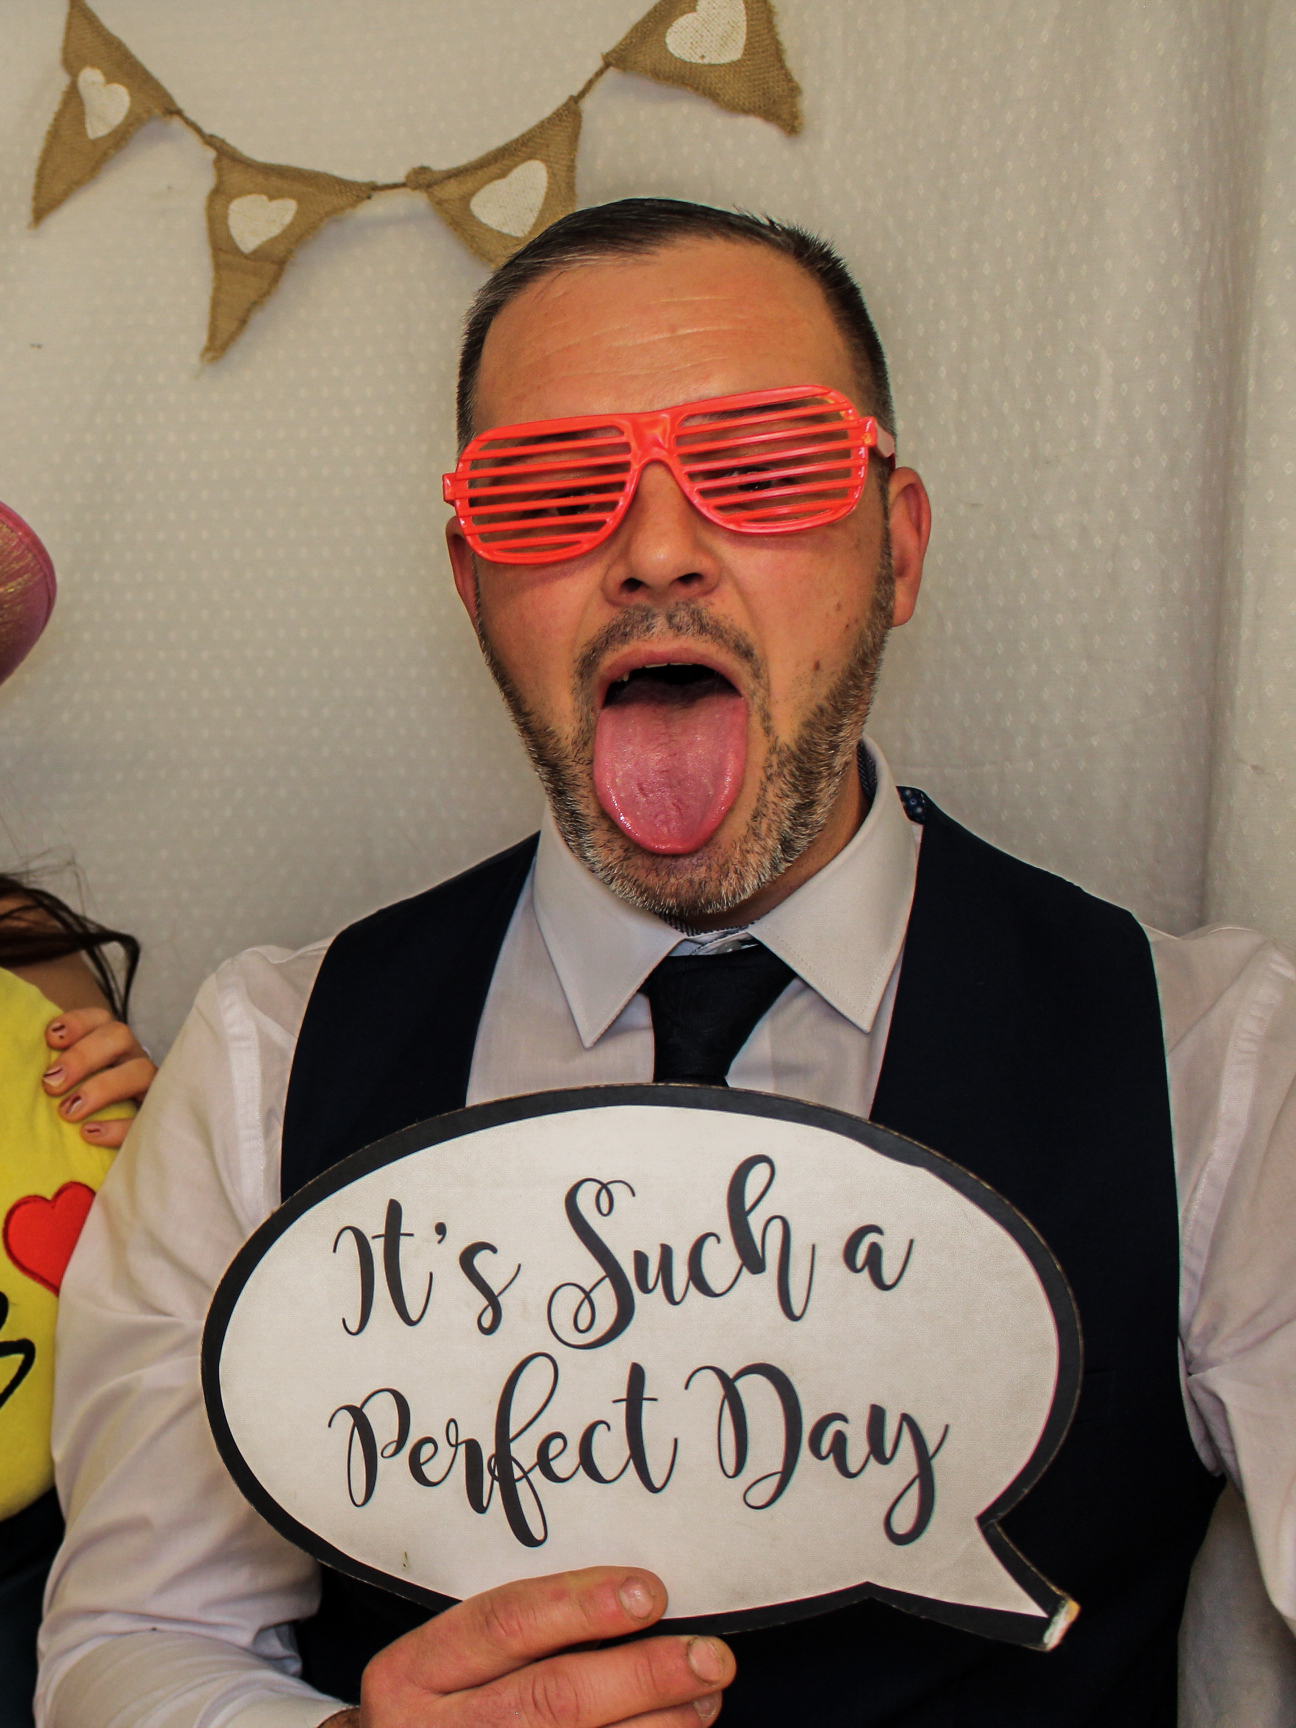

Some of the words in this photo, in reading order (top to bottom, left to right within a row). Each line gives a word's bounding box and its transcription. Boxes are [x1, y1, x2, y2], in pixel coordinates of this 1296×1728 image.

[332, 1198, 522, 1336] It's
[546, 1154, 816, 1350] Such
[842, 1224, 914, 1292] a
[327, 1352, 678, 1548] Perfect
[684, 1362, 950, 1547] Day
